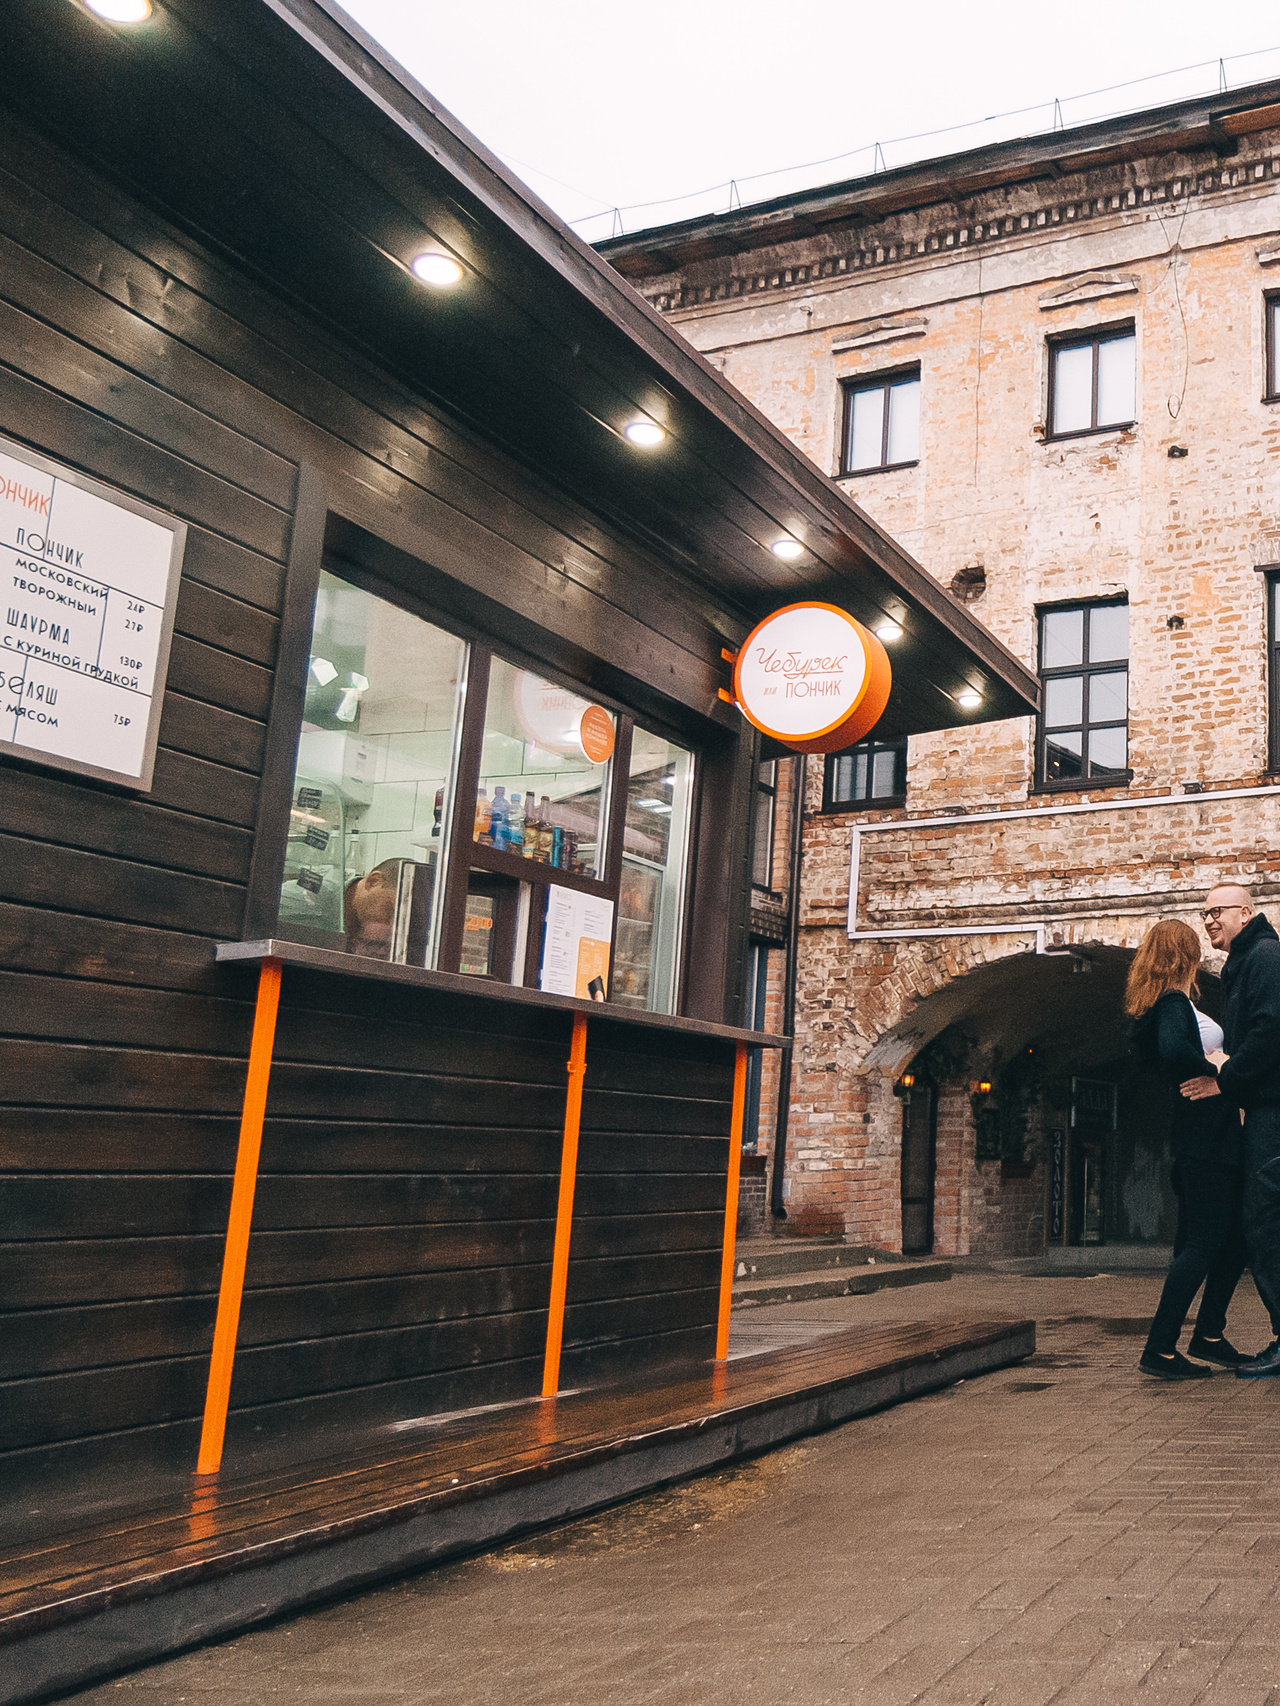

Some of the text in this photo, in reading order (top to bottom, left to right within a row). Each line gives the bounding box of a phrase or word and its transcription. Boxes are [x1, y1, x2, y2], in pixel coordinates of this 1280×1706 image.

[16, 527, 84, 569] ПОНЧИК
[15, 558, 109, 601] МОСКОВСКИЙ
[6, 607, 70, 645] ШАУРМА
[3, 635, 13, 646] С
[16, 640, 80, 669] КУРИНОЙ
[84, 662, 139, 690] ГРУДКОЙ
[756, 647, 848, 679] Чебурек
[785, 680, 842, 699] ПОНЧИК
[5, 703, 59, 728] МЯСОМ
